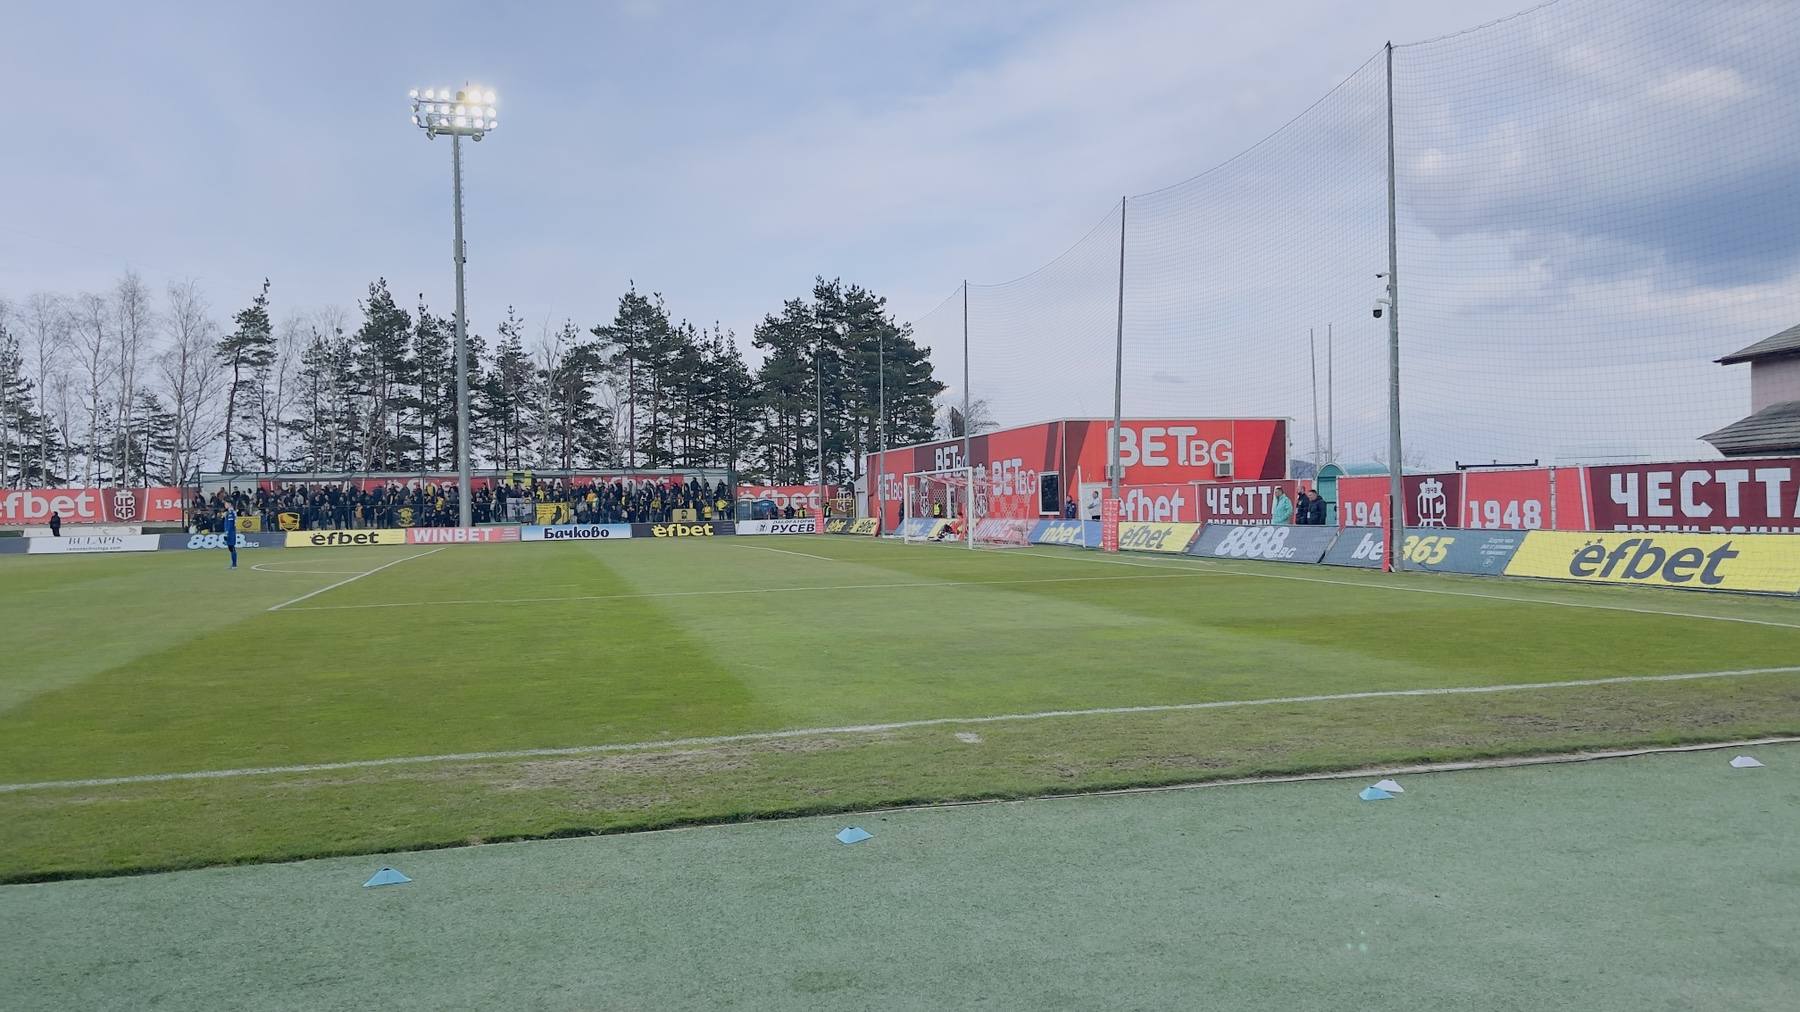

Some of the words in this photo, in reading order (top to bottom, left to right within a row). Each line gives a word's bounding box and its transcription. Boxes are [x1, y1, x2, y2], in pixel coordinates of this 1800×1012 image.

[0, 491, 95, 518] fbet
[1207, 485, 1282, 515] ЧЕСТТ
[1610, 467, 1800, 518] ЧЕСТТ
[1344, 502, 1383, 526] 194
[1469, 500, 1542, 530] 1948
[310, 532, 379, 546] efbet
[414, 528, 493, 543] WINBET
[544, 527, 610, 540] Бачково
[652, 523, 714, 538] efbet
[770, 523, 815, 533] РУСЕВ
[1569, 538, 1740, 585] efbet
